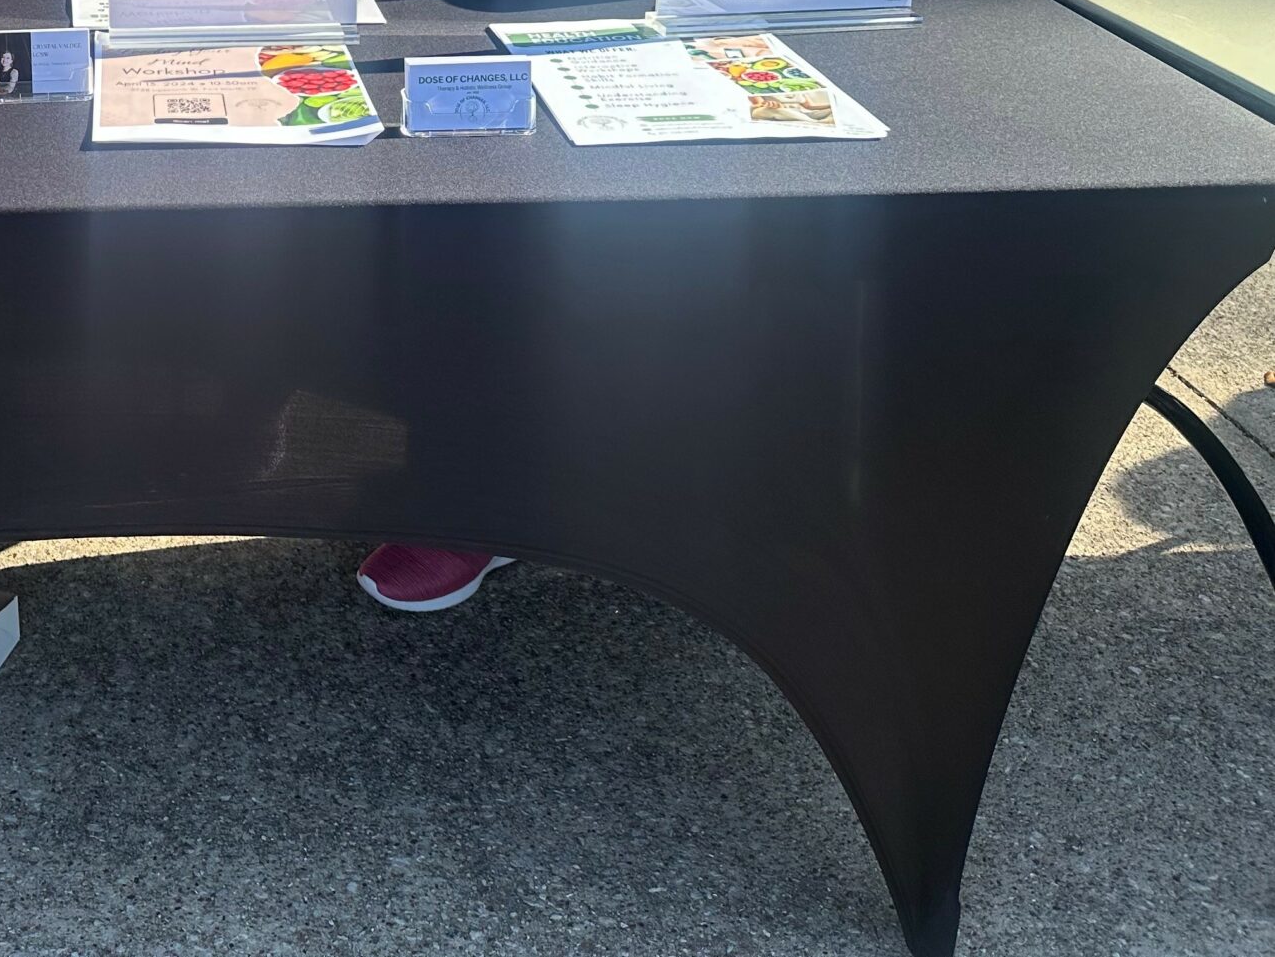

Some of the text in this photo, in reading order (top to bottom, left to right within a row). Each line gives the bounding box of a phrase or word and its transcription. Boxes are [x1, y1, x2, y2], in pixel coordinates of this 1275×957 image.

[527, 30, 597, 39] HEALTH
[531, 34, 644, 45] EDUCATION
[122, 67, 227, 77] Workshop
[418, 72, 529, 85] DOSE OF CHANGES, LLC
